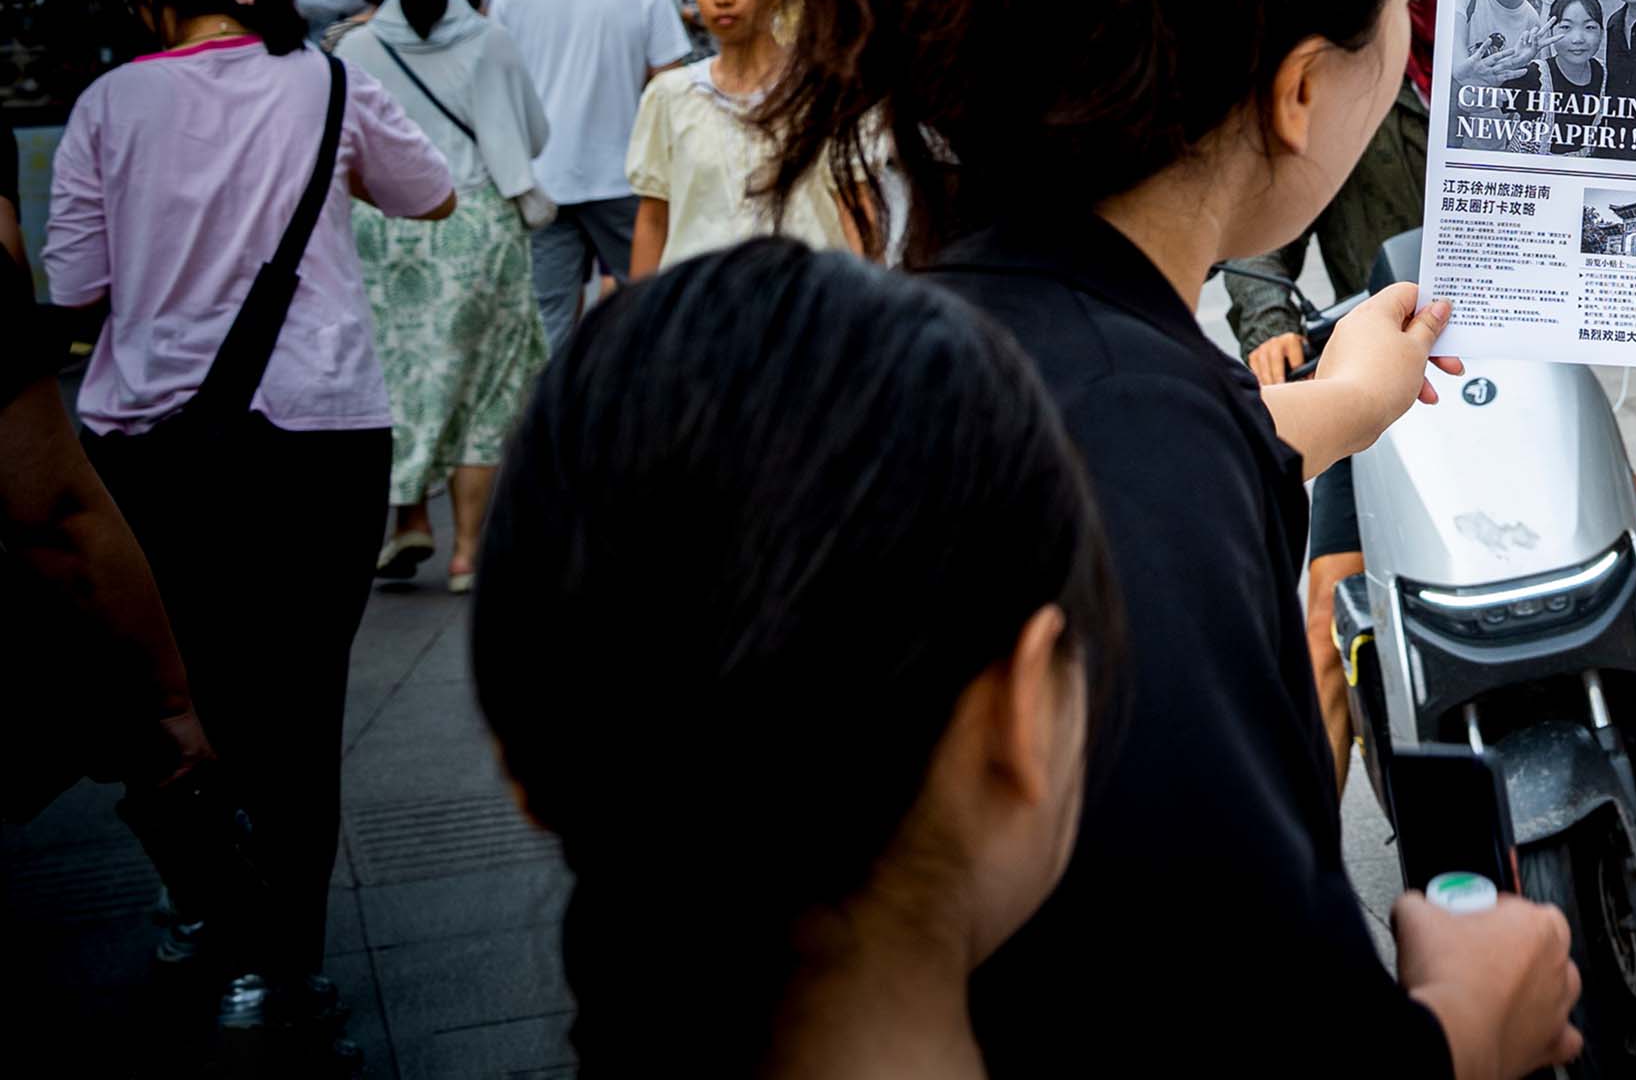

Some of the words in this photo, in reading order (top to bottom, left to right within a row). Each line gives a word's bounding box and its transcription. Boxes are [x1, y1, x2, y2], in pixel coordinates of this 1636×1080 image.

[1458, 85, 1523, 111] CITY
[1442, 178, 1552, 200] 江苏徐州旅游指南
[1440, 196, 1537, 217] 朋友圈打卡攻略
